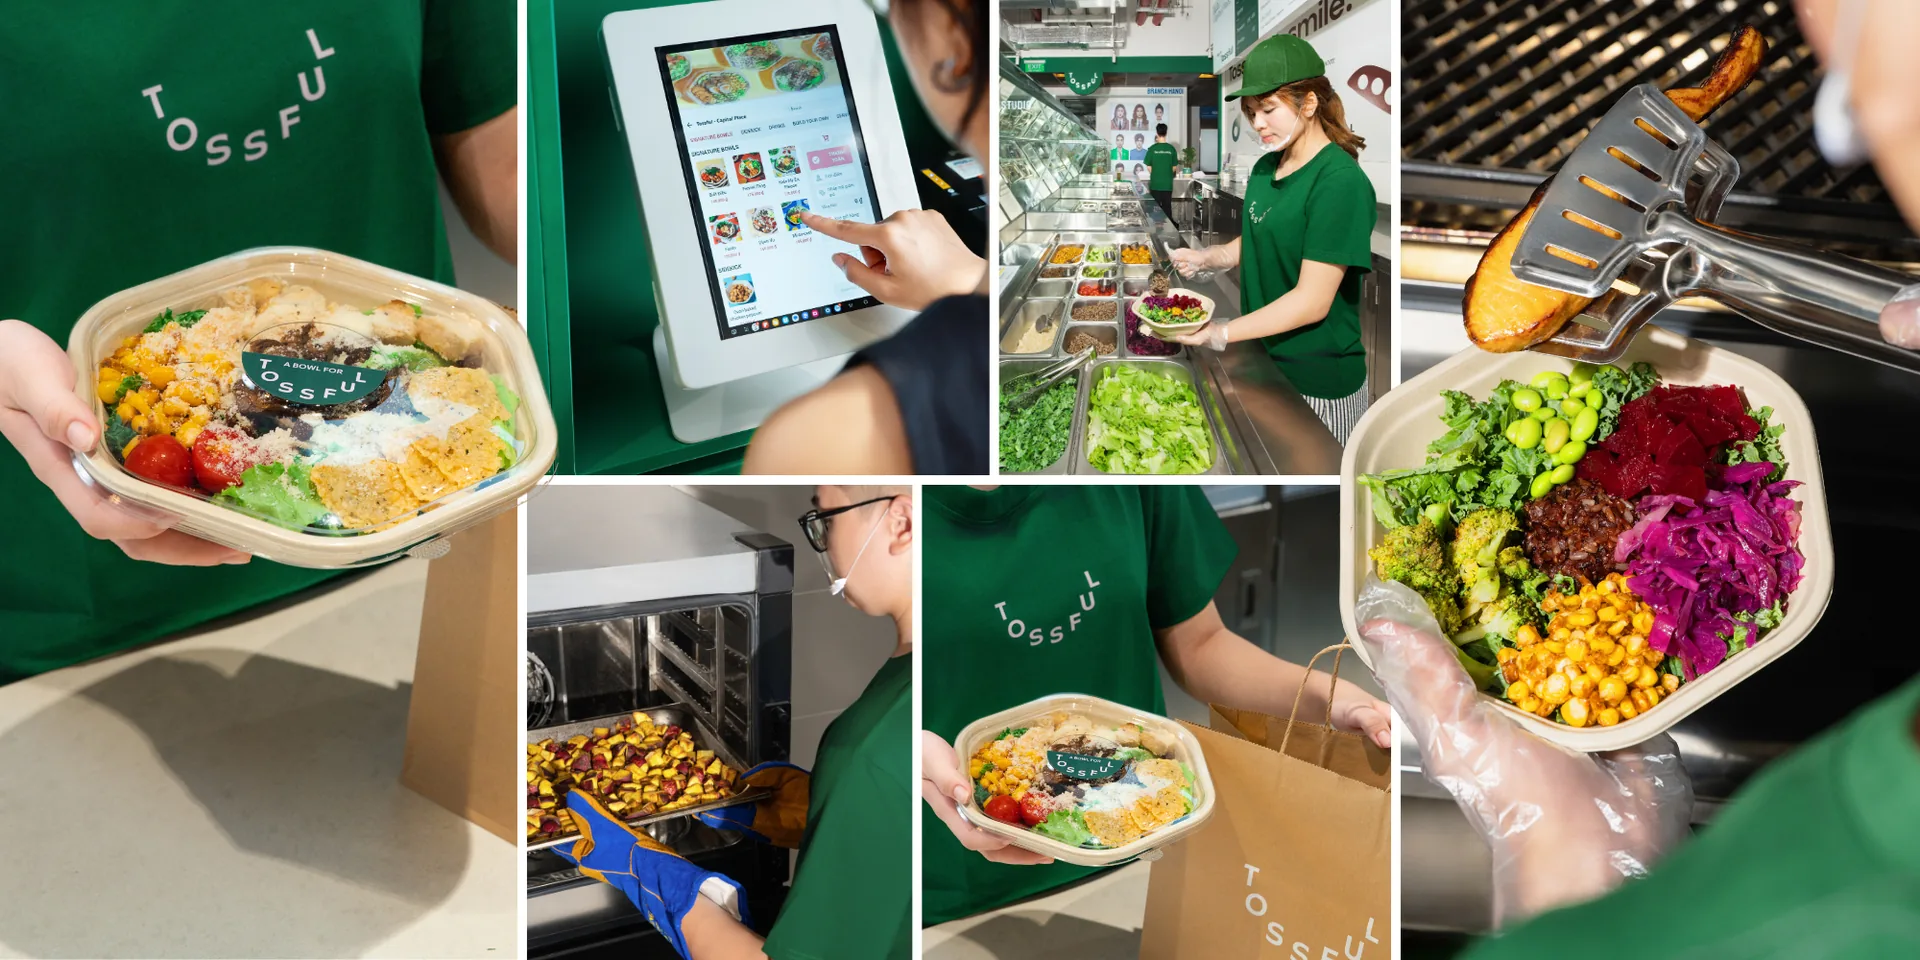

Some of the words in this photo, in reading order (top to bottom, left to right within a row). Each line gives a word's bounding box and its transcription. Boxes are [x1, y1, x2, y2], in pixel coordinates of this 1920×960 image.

[142, 28, 335, 166] TOSSFUL
[1068, 72, 1098, 90] TOSSFUL
[259, 358, 367, 400] TOSSFUL
[293, 362, 321, 372] BOWL
[323, 366, 344, 375] FOR
[994, 570, 1100, 646] TOSSFUL
[1056, 753, 1114, 777] TOSSFUL
[1244, 863, 1380, 960] TOSSFUL
